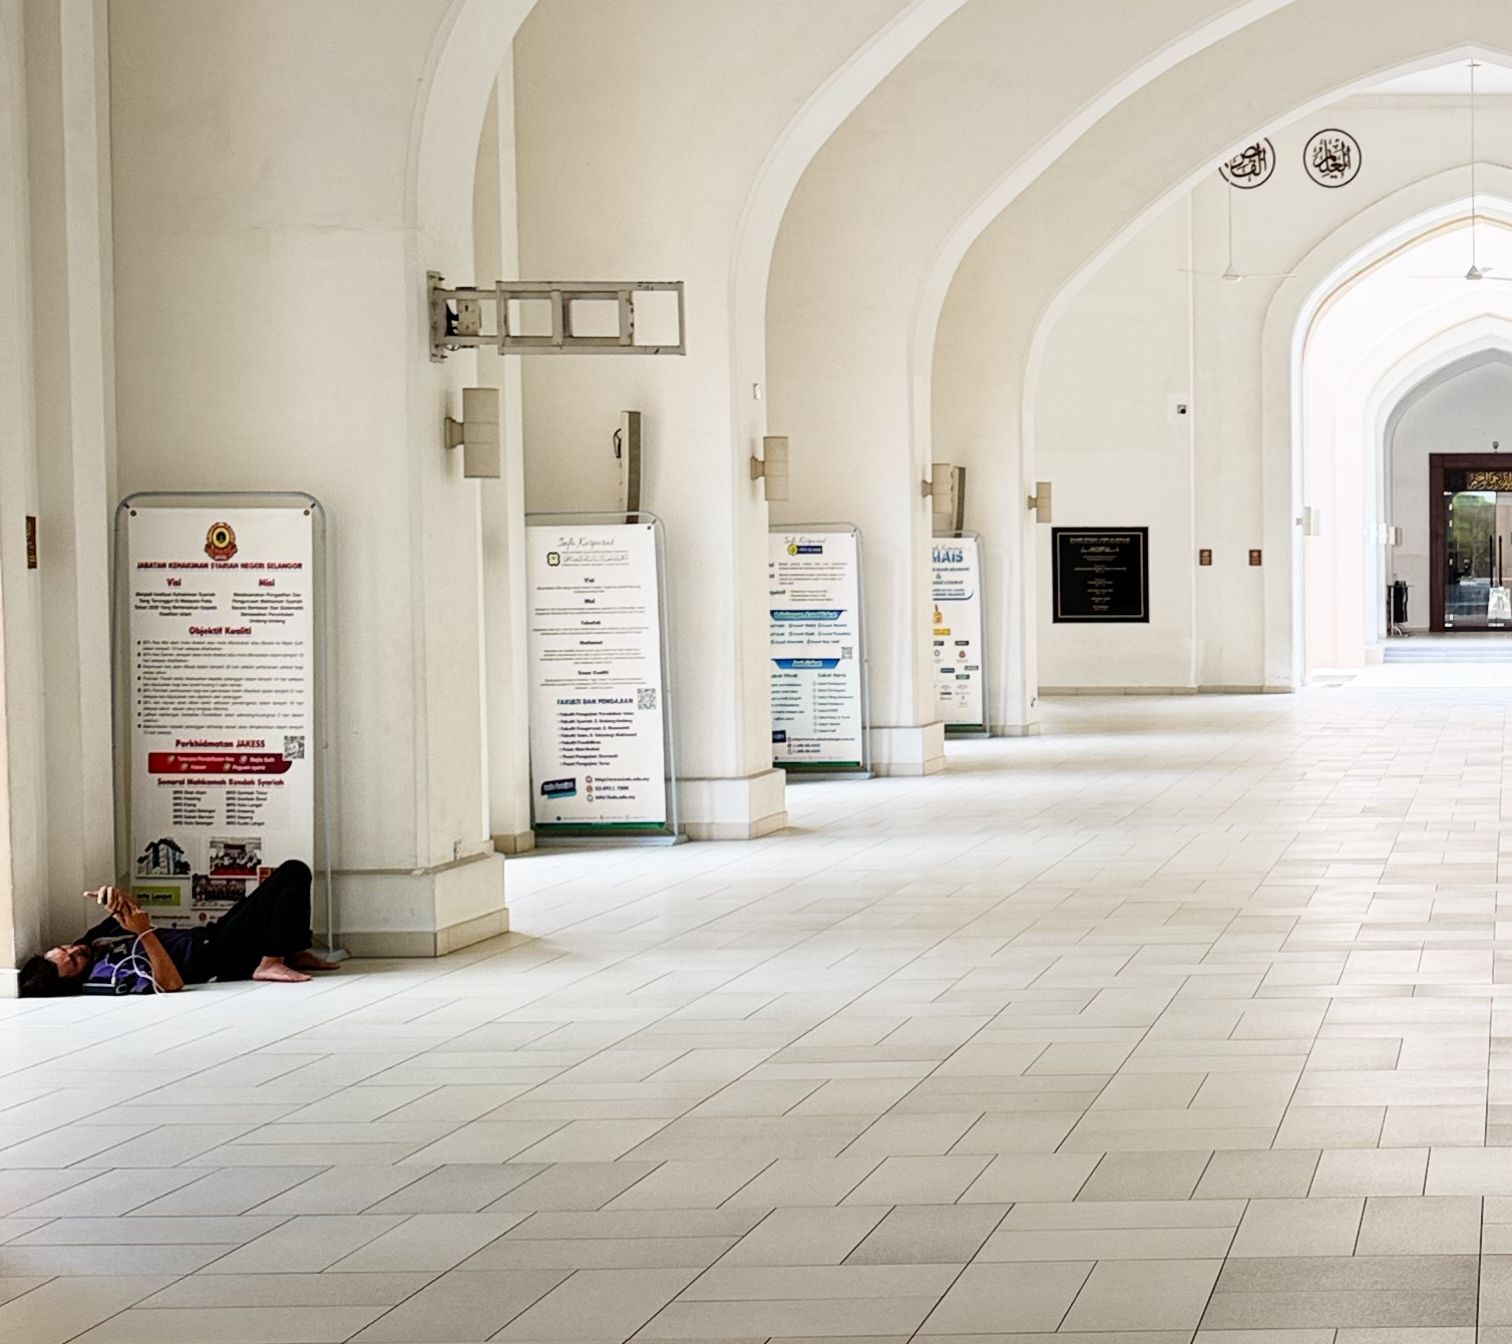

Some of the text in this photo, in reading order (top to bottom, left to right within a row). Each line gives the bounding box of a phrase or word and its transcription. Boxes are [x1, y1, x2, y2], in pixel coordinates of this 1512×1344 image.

[137, 562, 302, 570] JABATAN KEHAKIMAN SYARIAH NEGERI SELANGOR
[167, 578, 182, 587] Visi
[258, 578, 275, 587] Misi
[189, 627, 251, 636] Objektif Kualiti
[176, 739, 265, 748] Perkhidmatan JAKESS
[158, 778, 284, 787] Senarai Mahkamah Rendah Syariah
